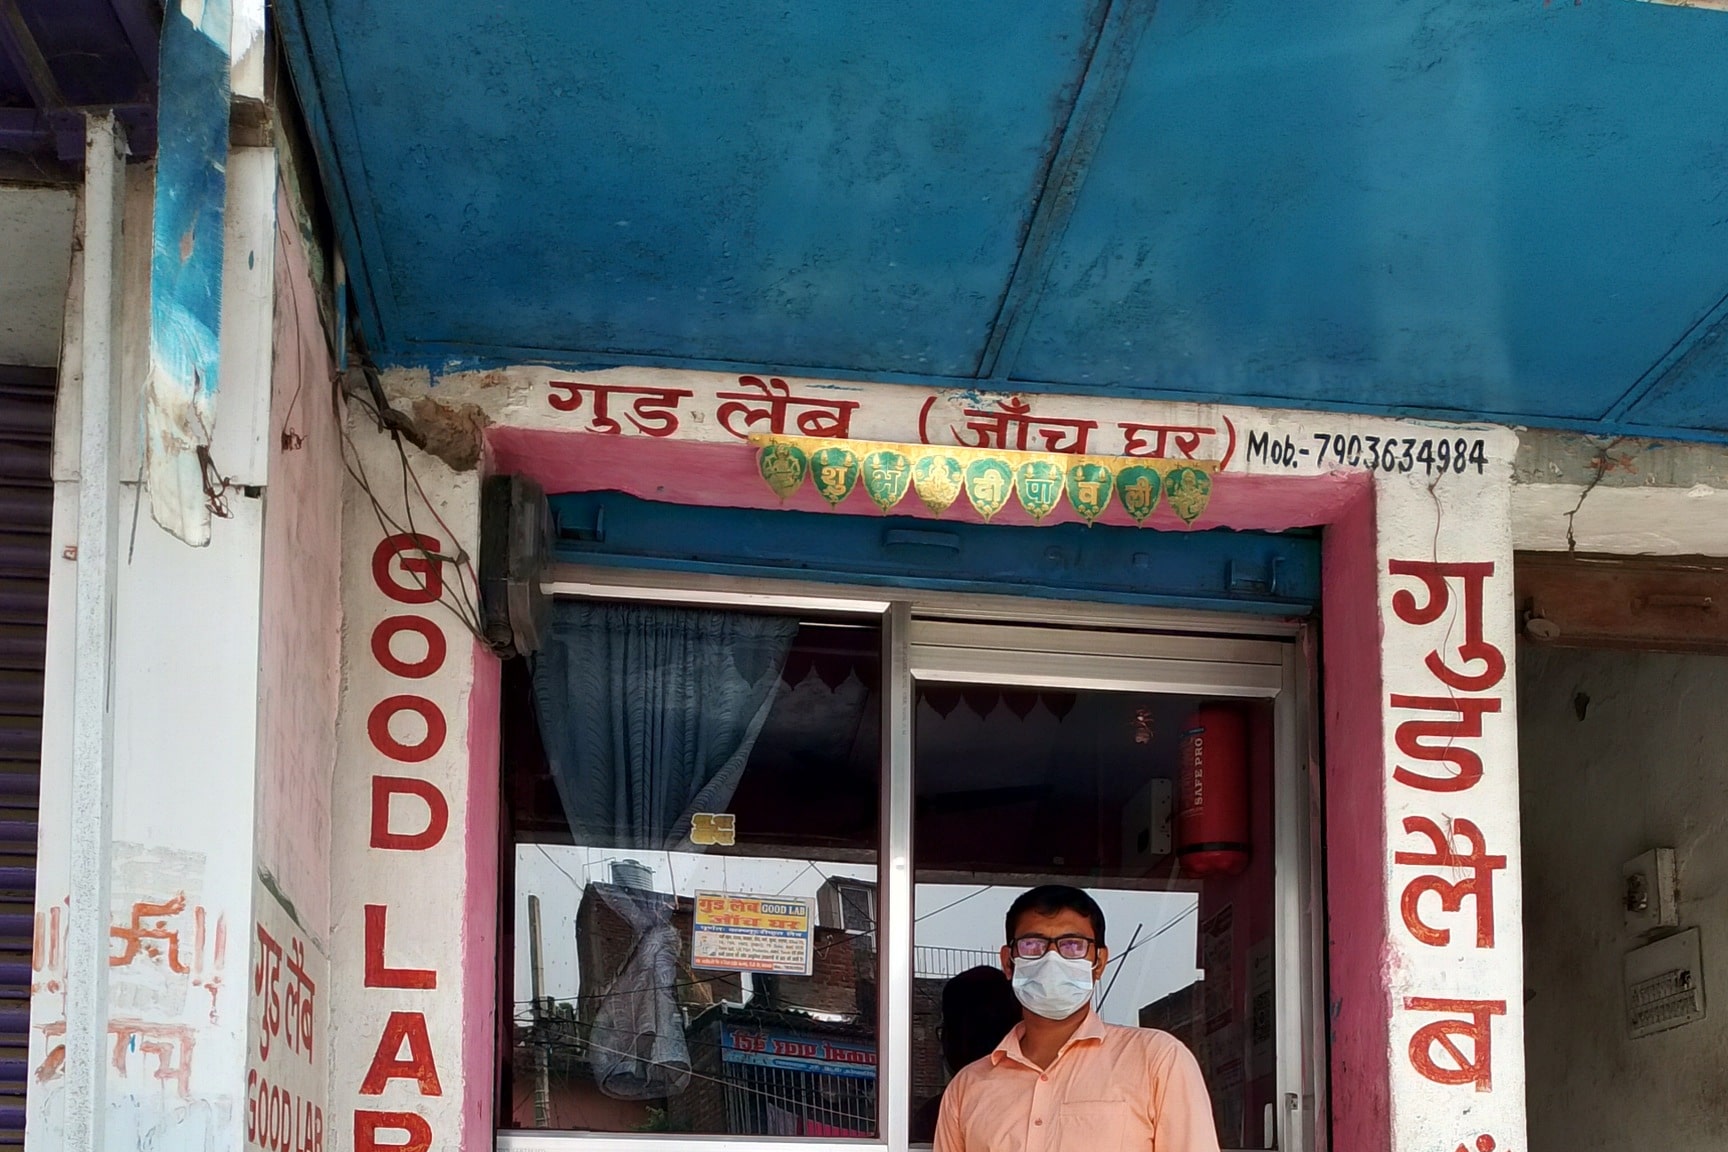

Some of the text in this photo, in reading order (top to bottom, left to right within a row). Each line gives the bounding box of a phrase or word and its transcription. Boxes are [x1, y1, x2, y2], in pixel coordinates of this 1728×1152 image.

[549, 380, 694, 437] गुड
[716, 375, 860, 439] लैब
[366, 532, 450, 852] GOOD
[1388, 559, 1507, 793] गुड
[1194, 738, 1204, 806] SAFE PRO
[761, 903, 806, 916] GOOD LAB
[1395, 815, 1508, 1094] लैब
[256, 921, 282, 1062] गुड
[287, 936, 315, 1065] लैब
